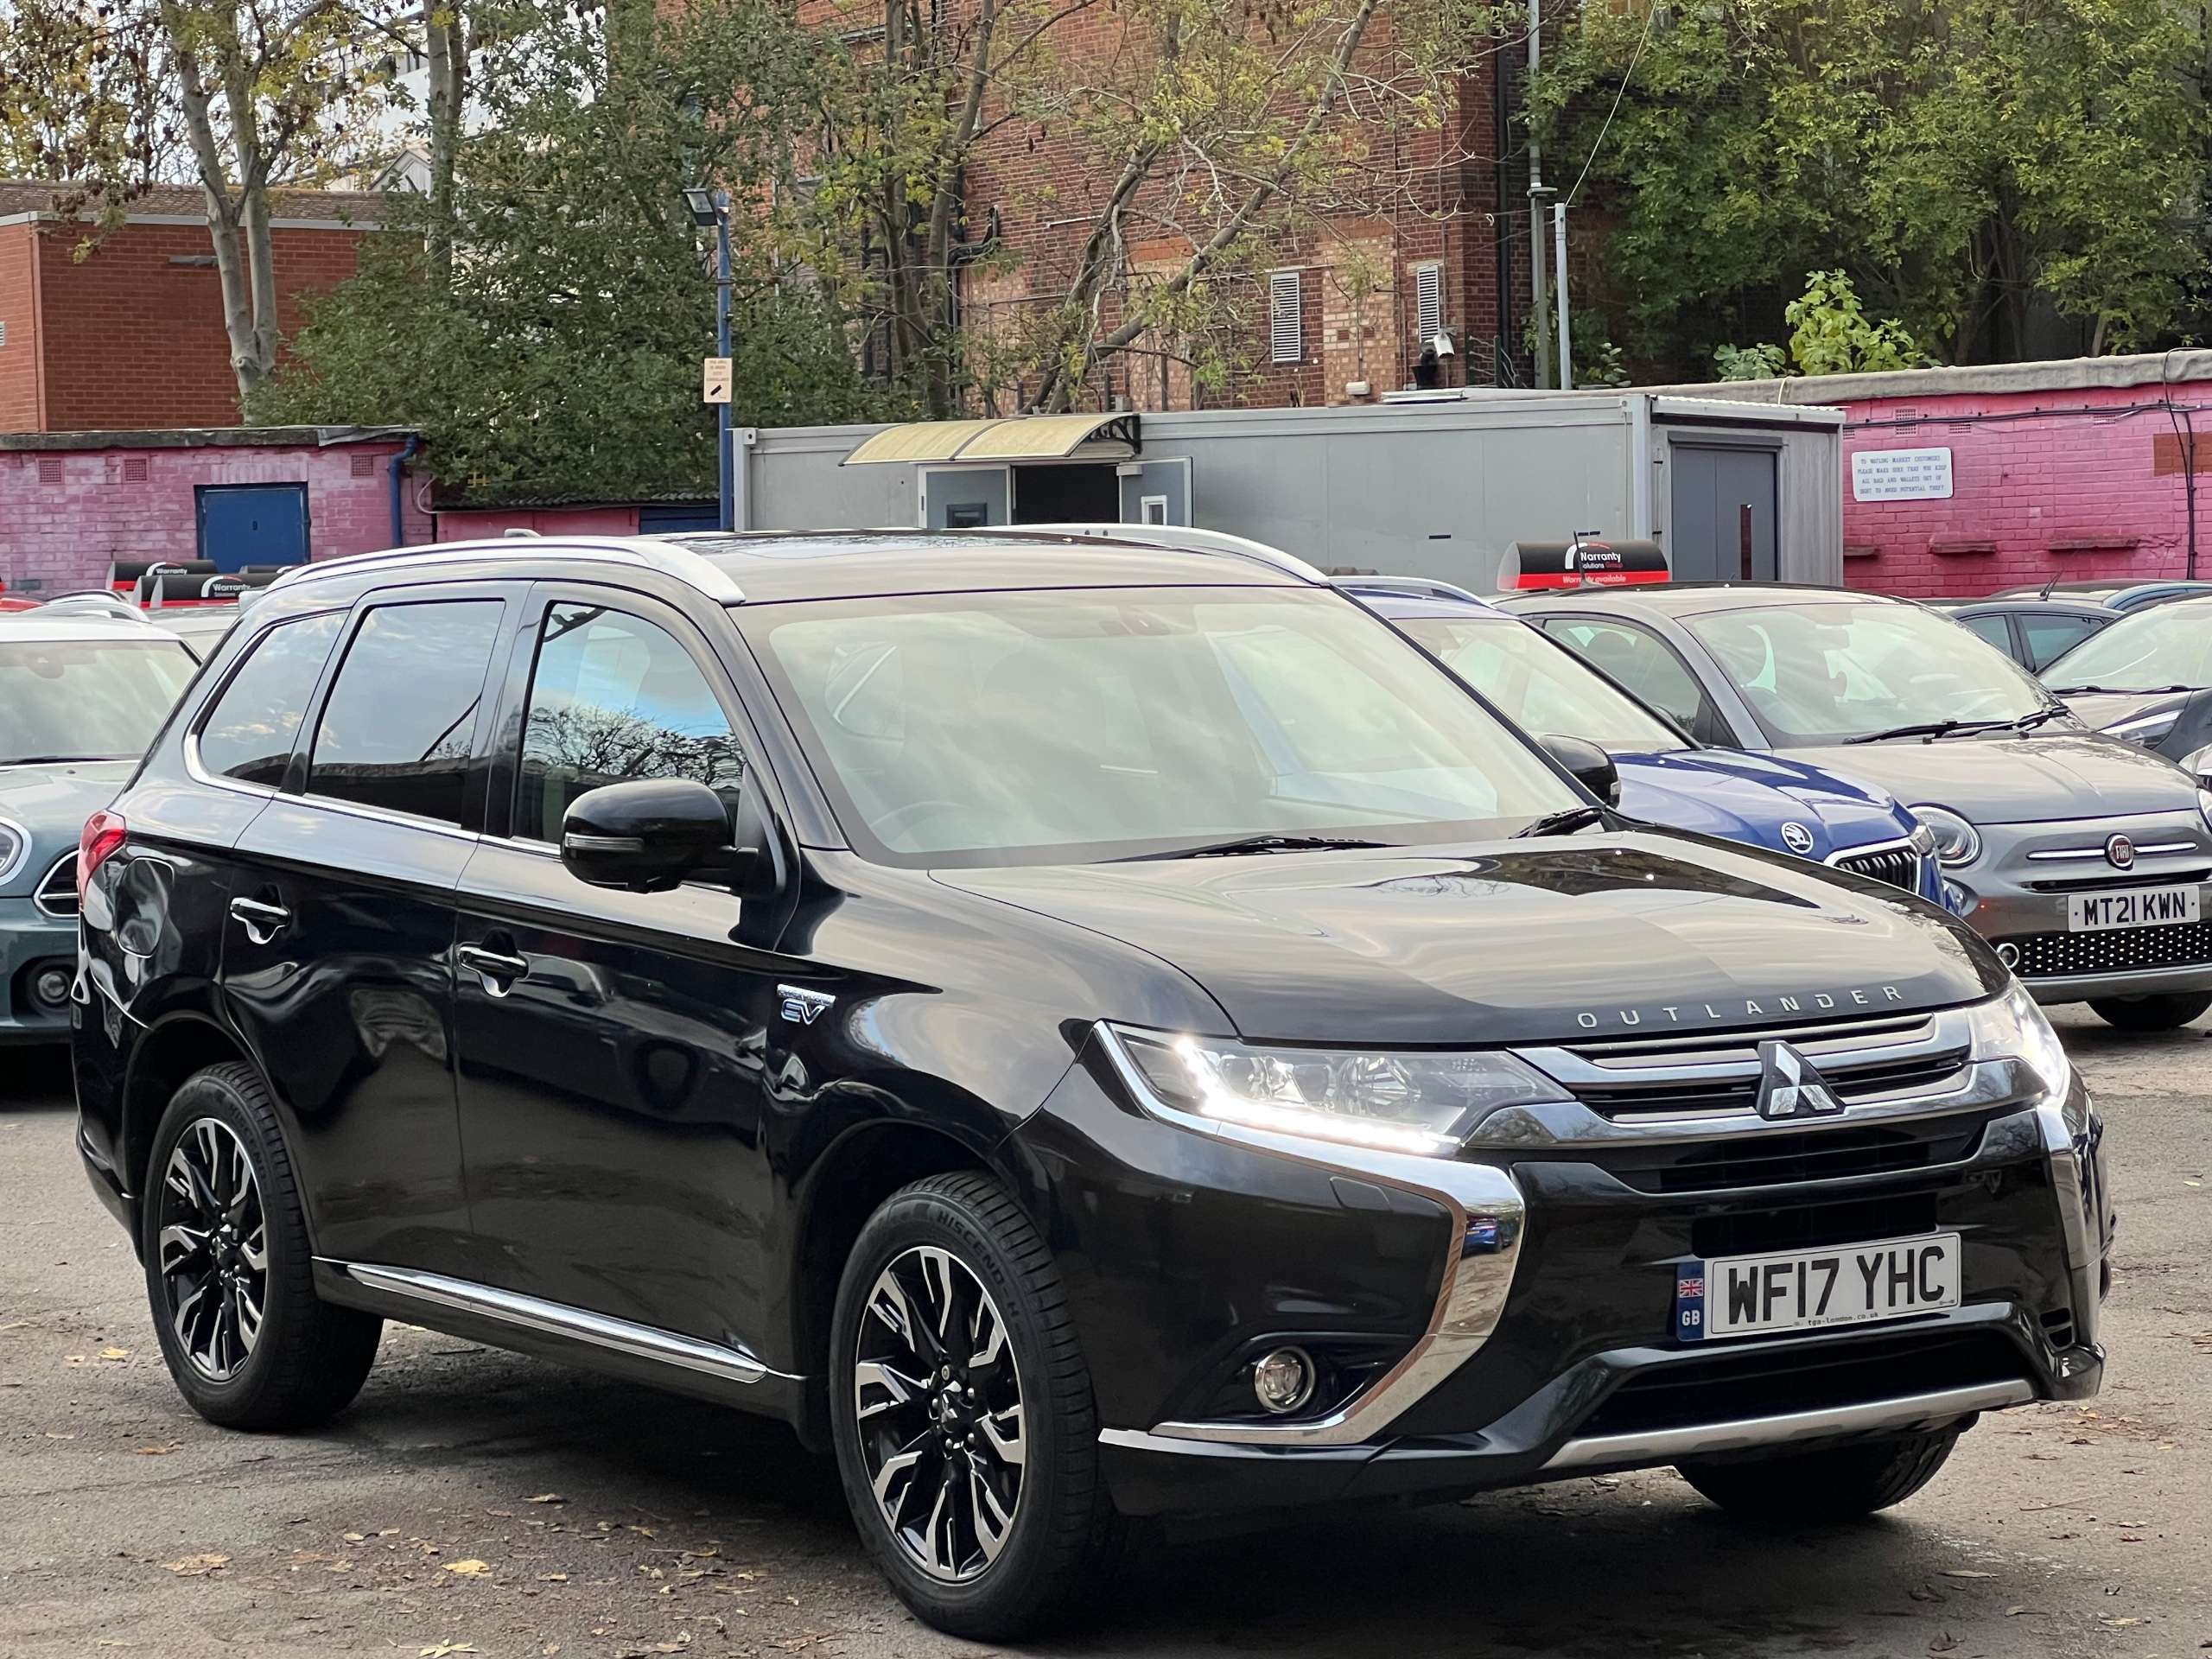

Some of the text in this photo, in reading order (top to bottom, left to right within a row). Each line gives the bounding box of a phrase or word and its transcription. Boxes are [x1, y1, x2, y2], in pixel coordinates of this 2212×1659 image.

[1594, 575, 1626, 584] available
[2114, 844, 2129, 860] FIAT
[2083, 891, 2186, 926] MT21 KWN
[780, 997, 826, 1026] EV
[1577, 985, 1902, 1029] OUTLANDER
[1728, 1245, 1945, 1325] WF17 YHC
[1681, 1309, 1701, 1327] GB
